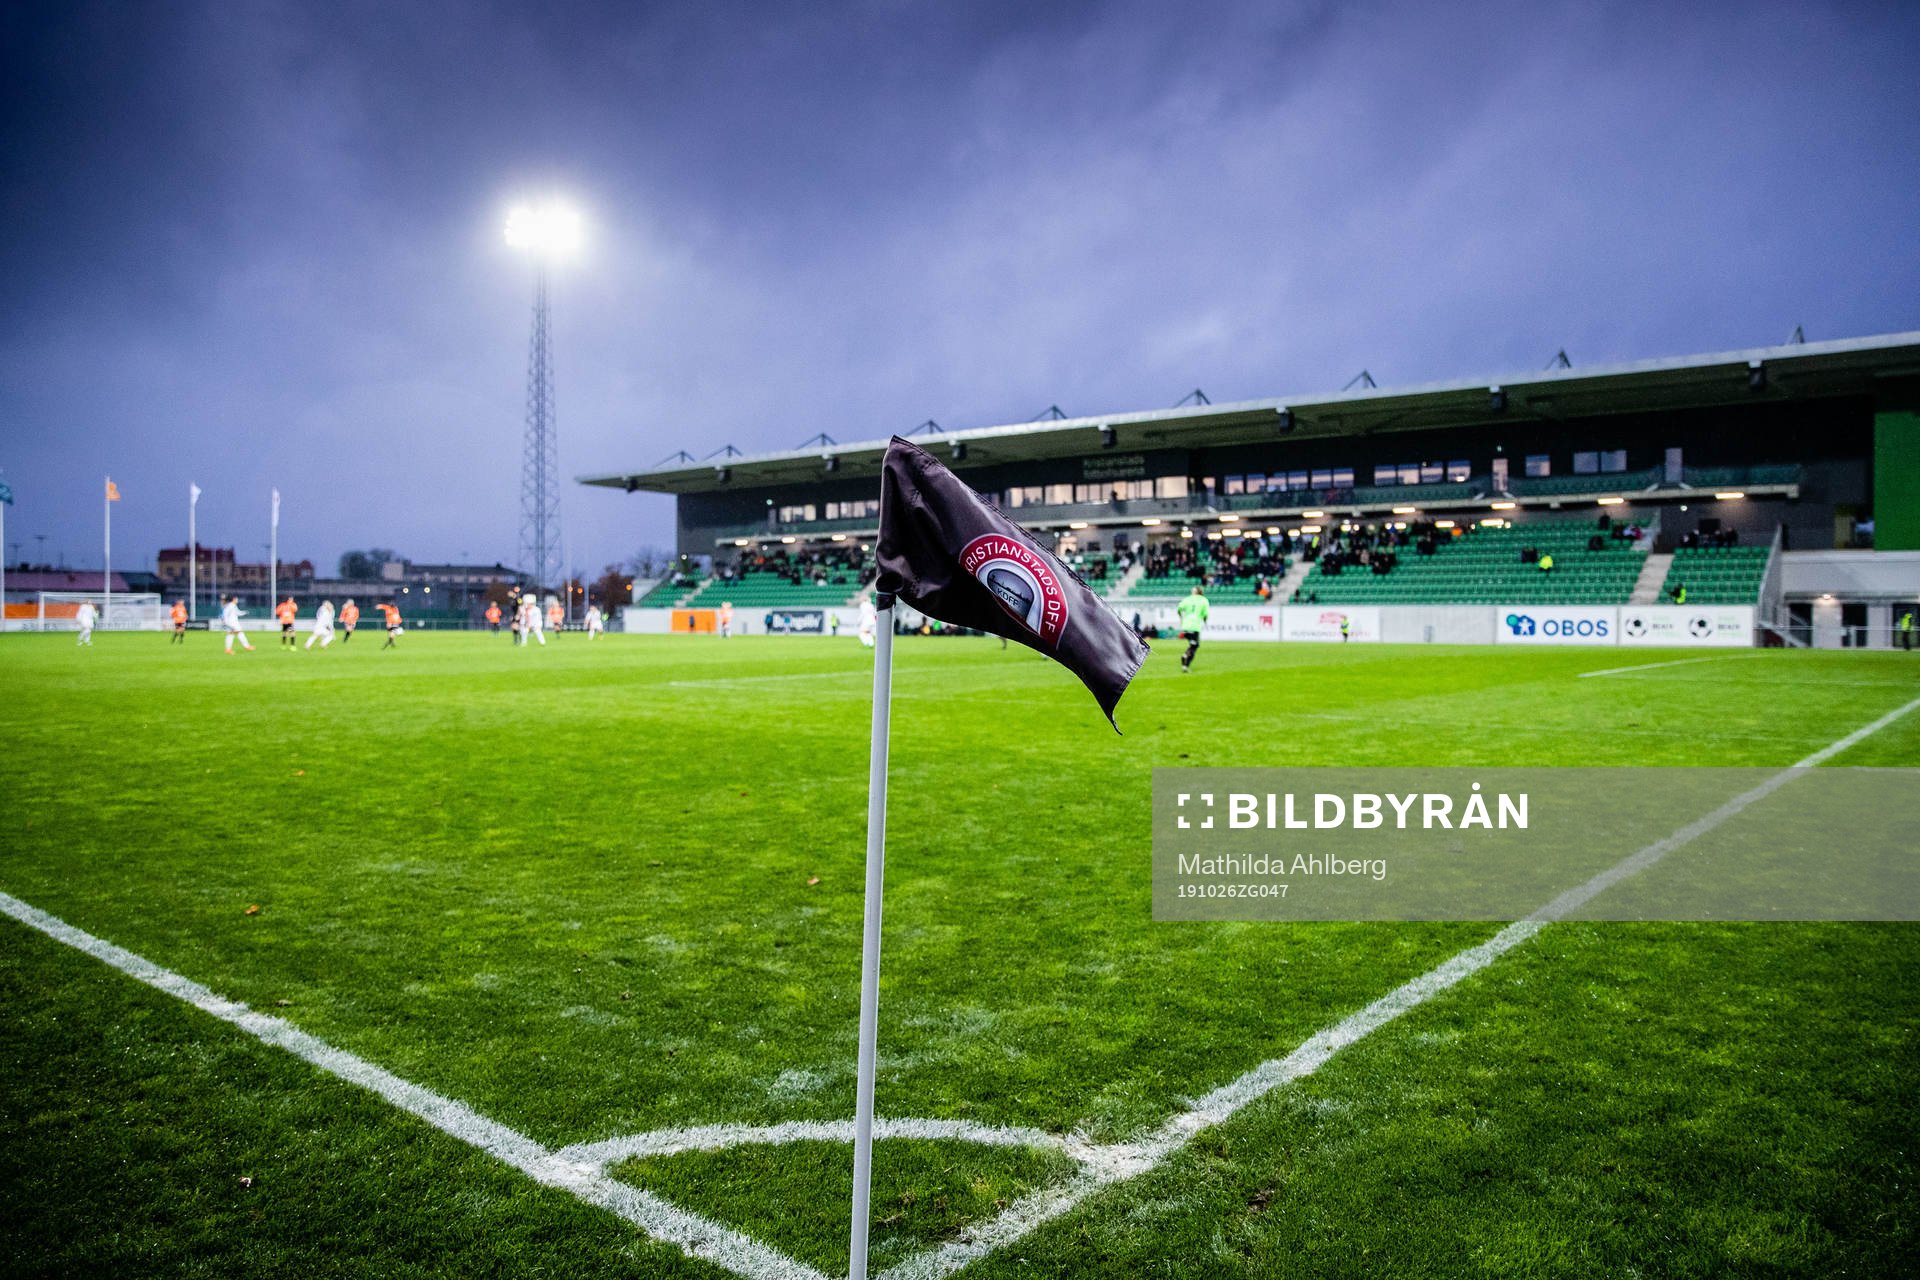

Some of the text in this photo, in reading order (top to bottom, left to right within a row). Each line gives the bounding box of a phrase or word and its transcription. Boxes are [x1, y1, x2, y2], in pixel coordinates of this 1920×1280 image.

[997, 588, 1019, 606] KDFF
[1045, 600, 1061, 633] DFF
[1543, 619, 1609, 637] OBOS
